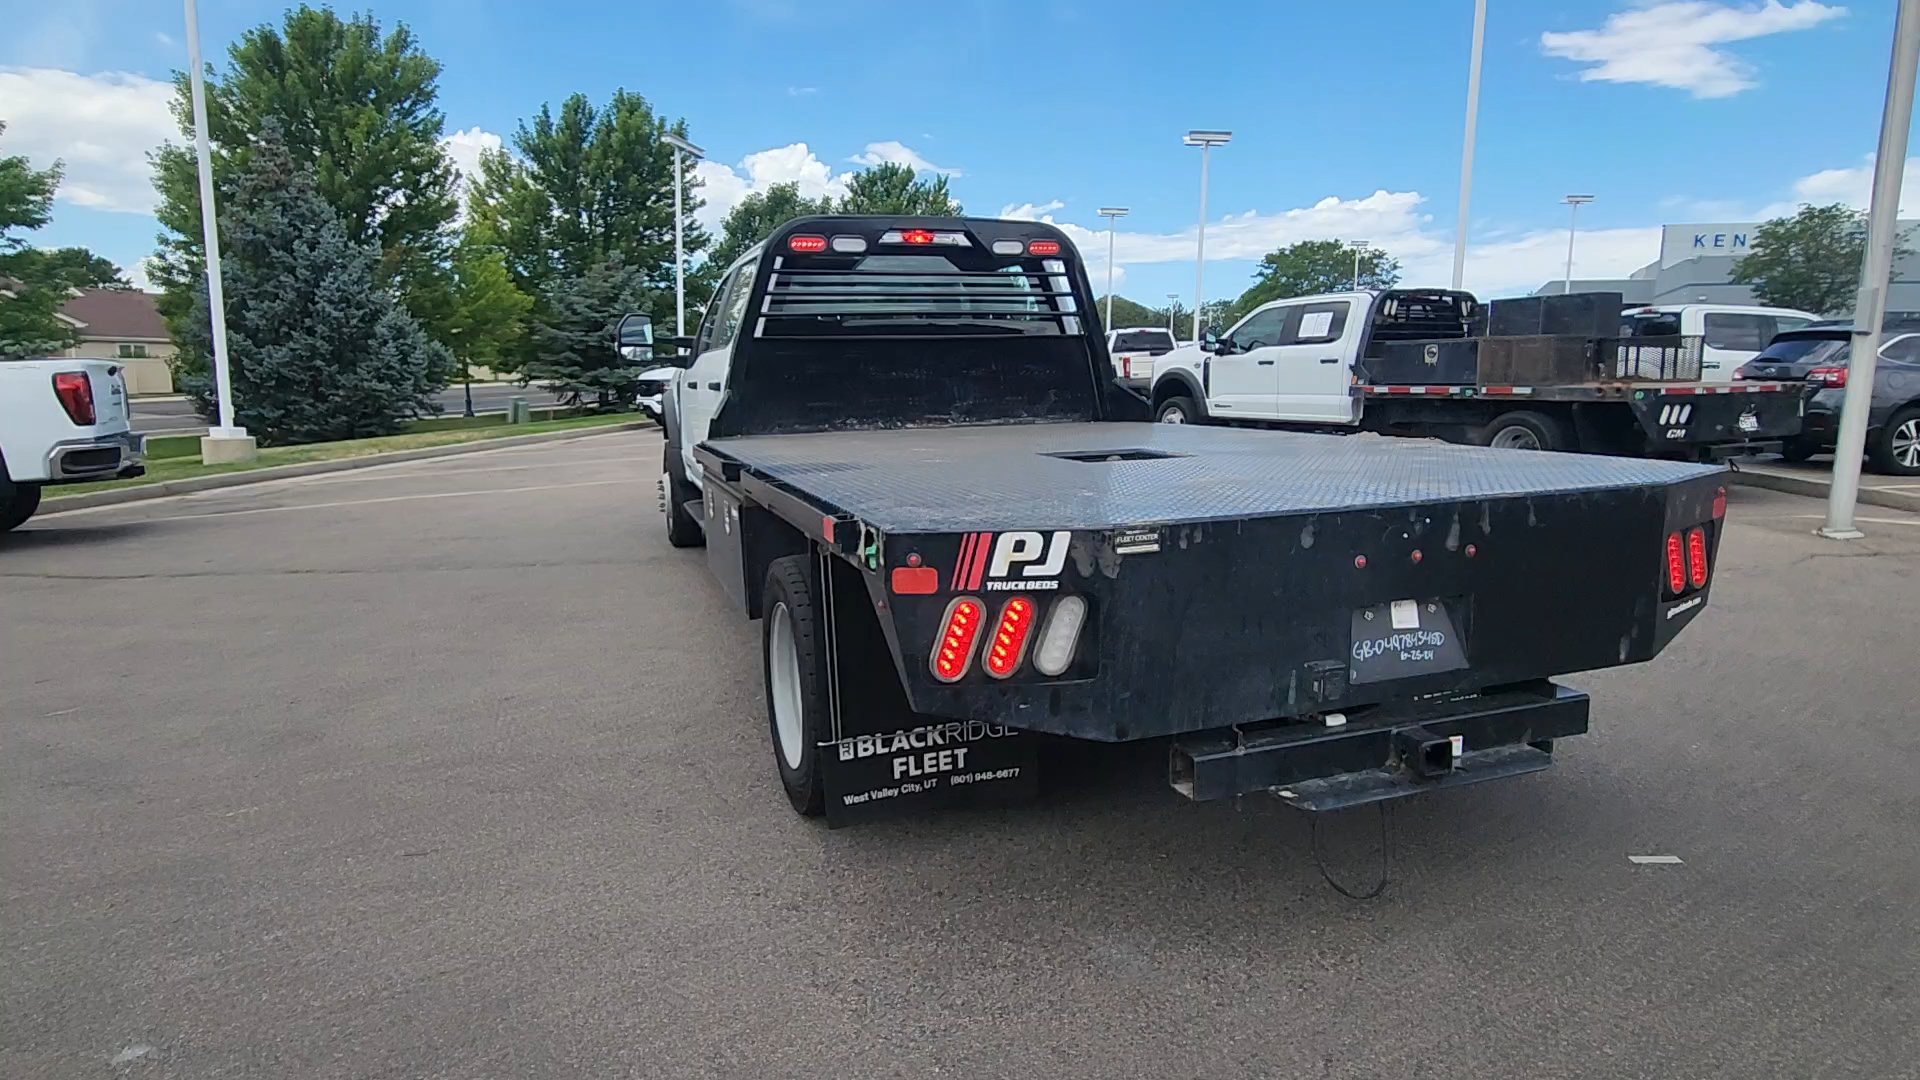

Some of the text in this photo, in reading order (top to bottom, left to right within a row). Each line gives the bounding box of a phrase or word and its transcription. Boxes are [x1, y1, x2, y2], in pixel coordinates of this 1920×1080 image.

[1694, 233, 1747, 248] KEN
[1666, 428, 1686, 439] CM
[989, 531, 1071, 576] PJ
[892, 747, 968, 779] FLEET
[843, 792, 869, 806] West
[870, 787, 899, 800] Valley
[901, 783, 923, 794] City,
[924, 778, 938, 789] UT
